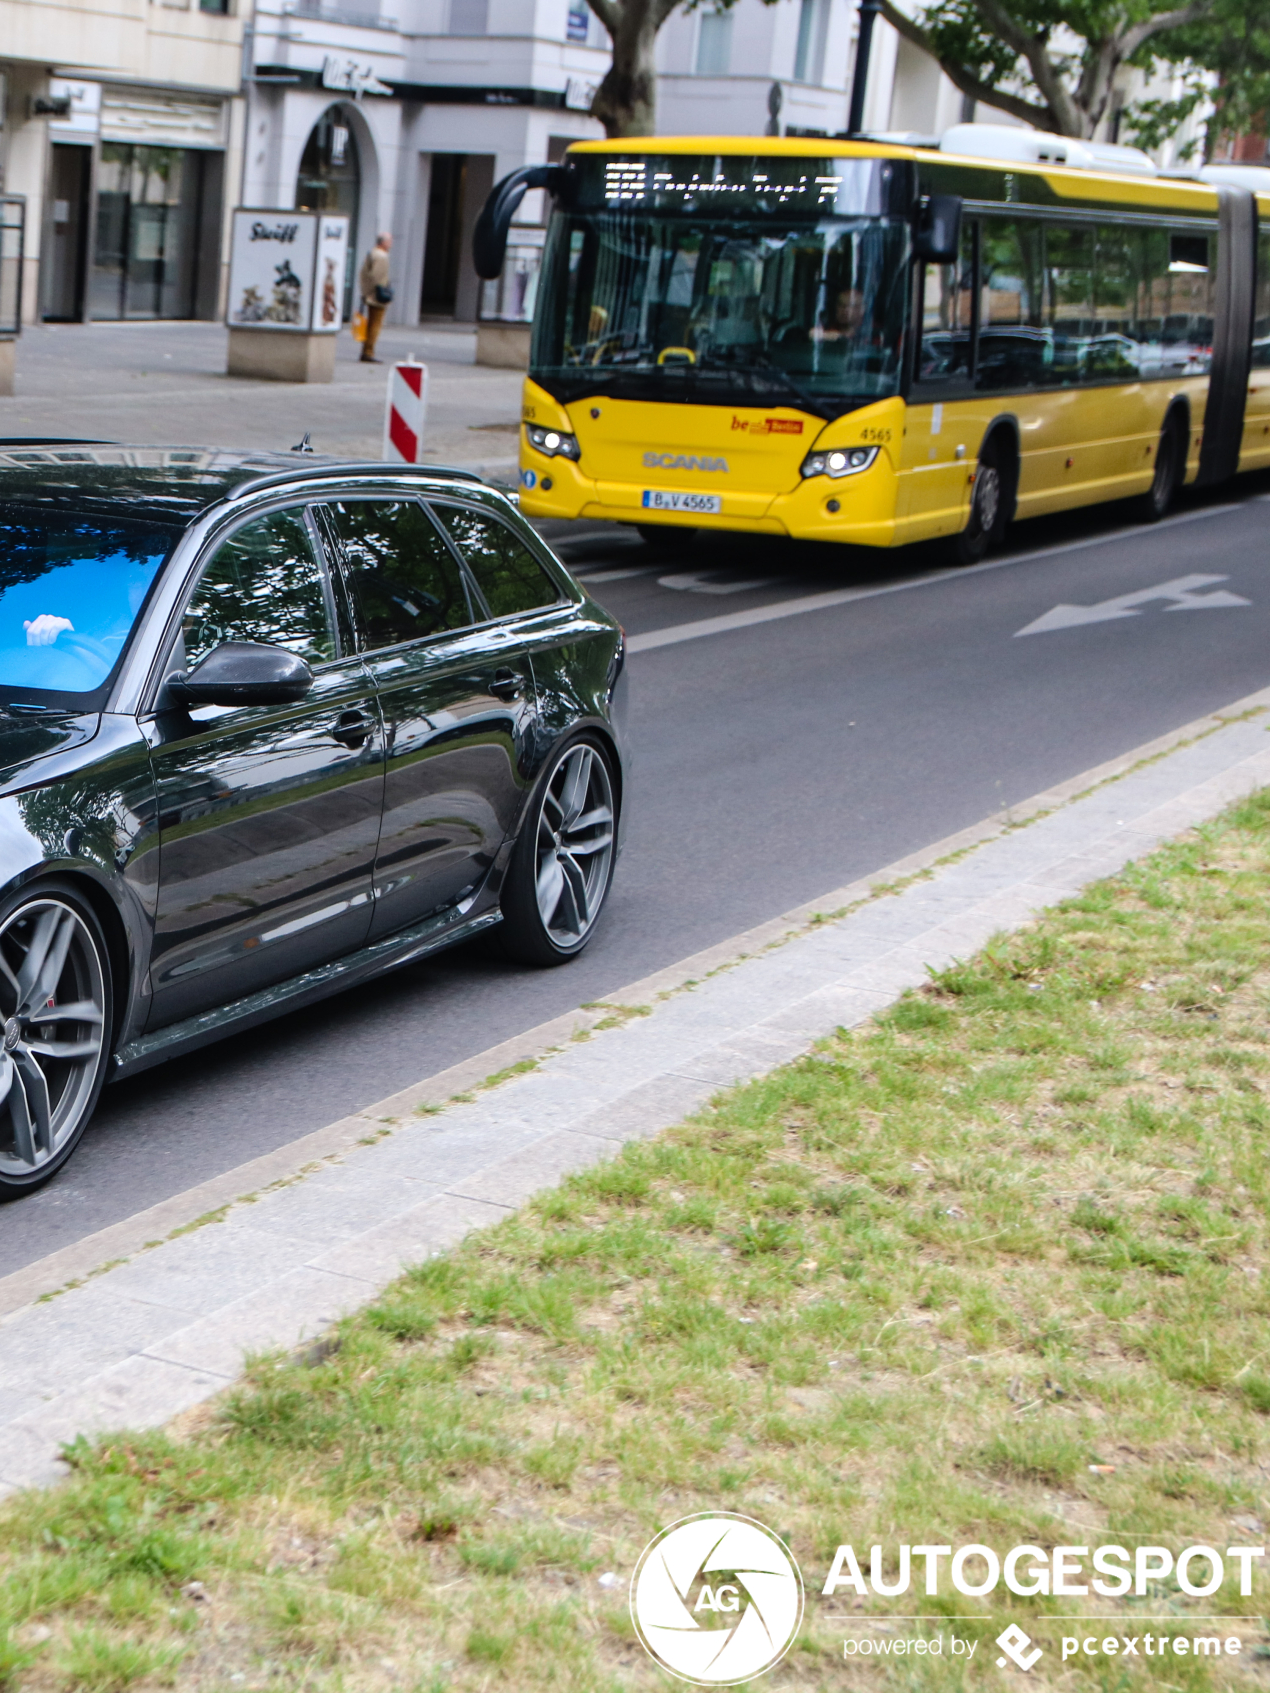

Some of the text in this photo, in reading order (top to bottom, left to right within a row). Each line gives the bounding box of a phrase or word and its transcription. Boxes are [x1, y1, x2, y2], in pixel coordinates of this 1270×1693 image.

[249, 222, 298, 243] Steiff
[860, 427, 892, 442] 4565
[642, 452, 729, 473] SCANIA
[655, 492, 715, 510] B V 4565
